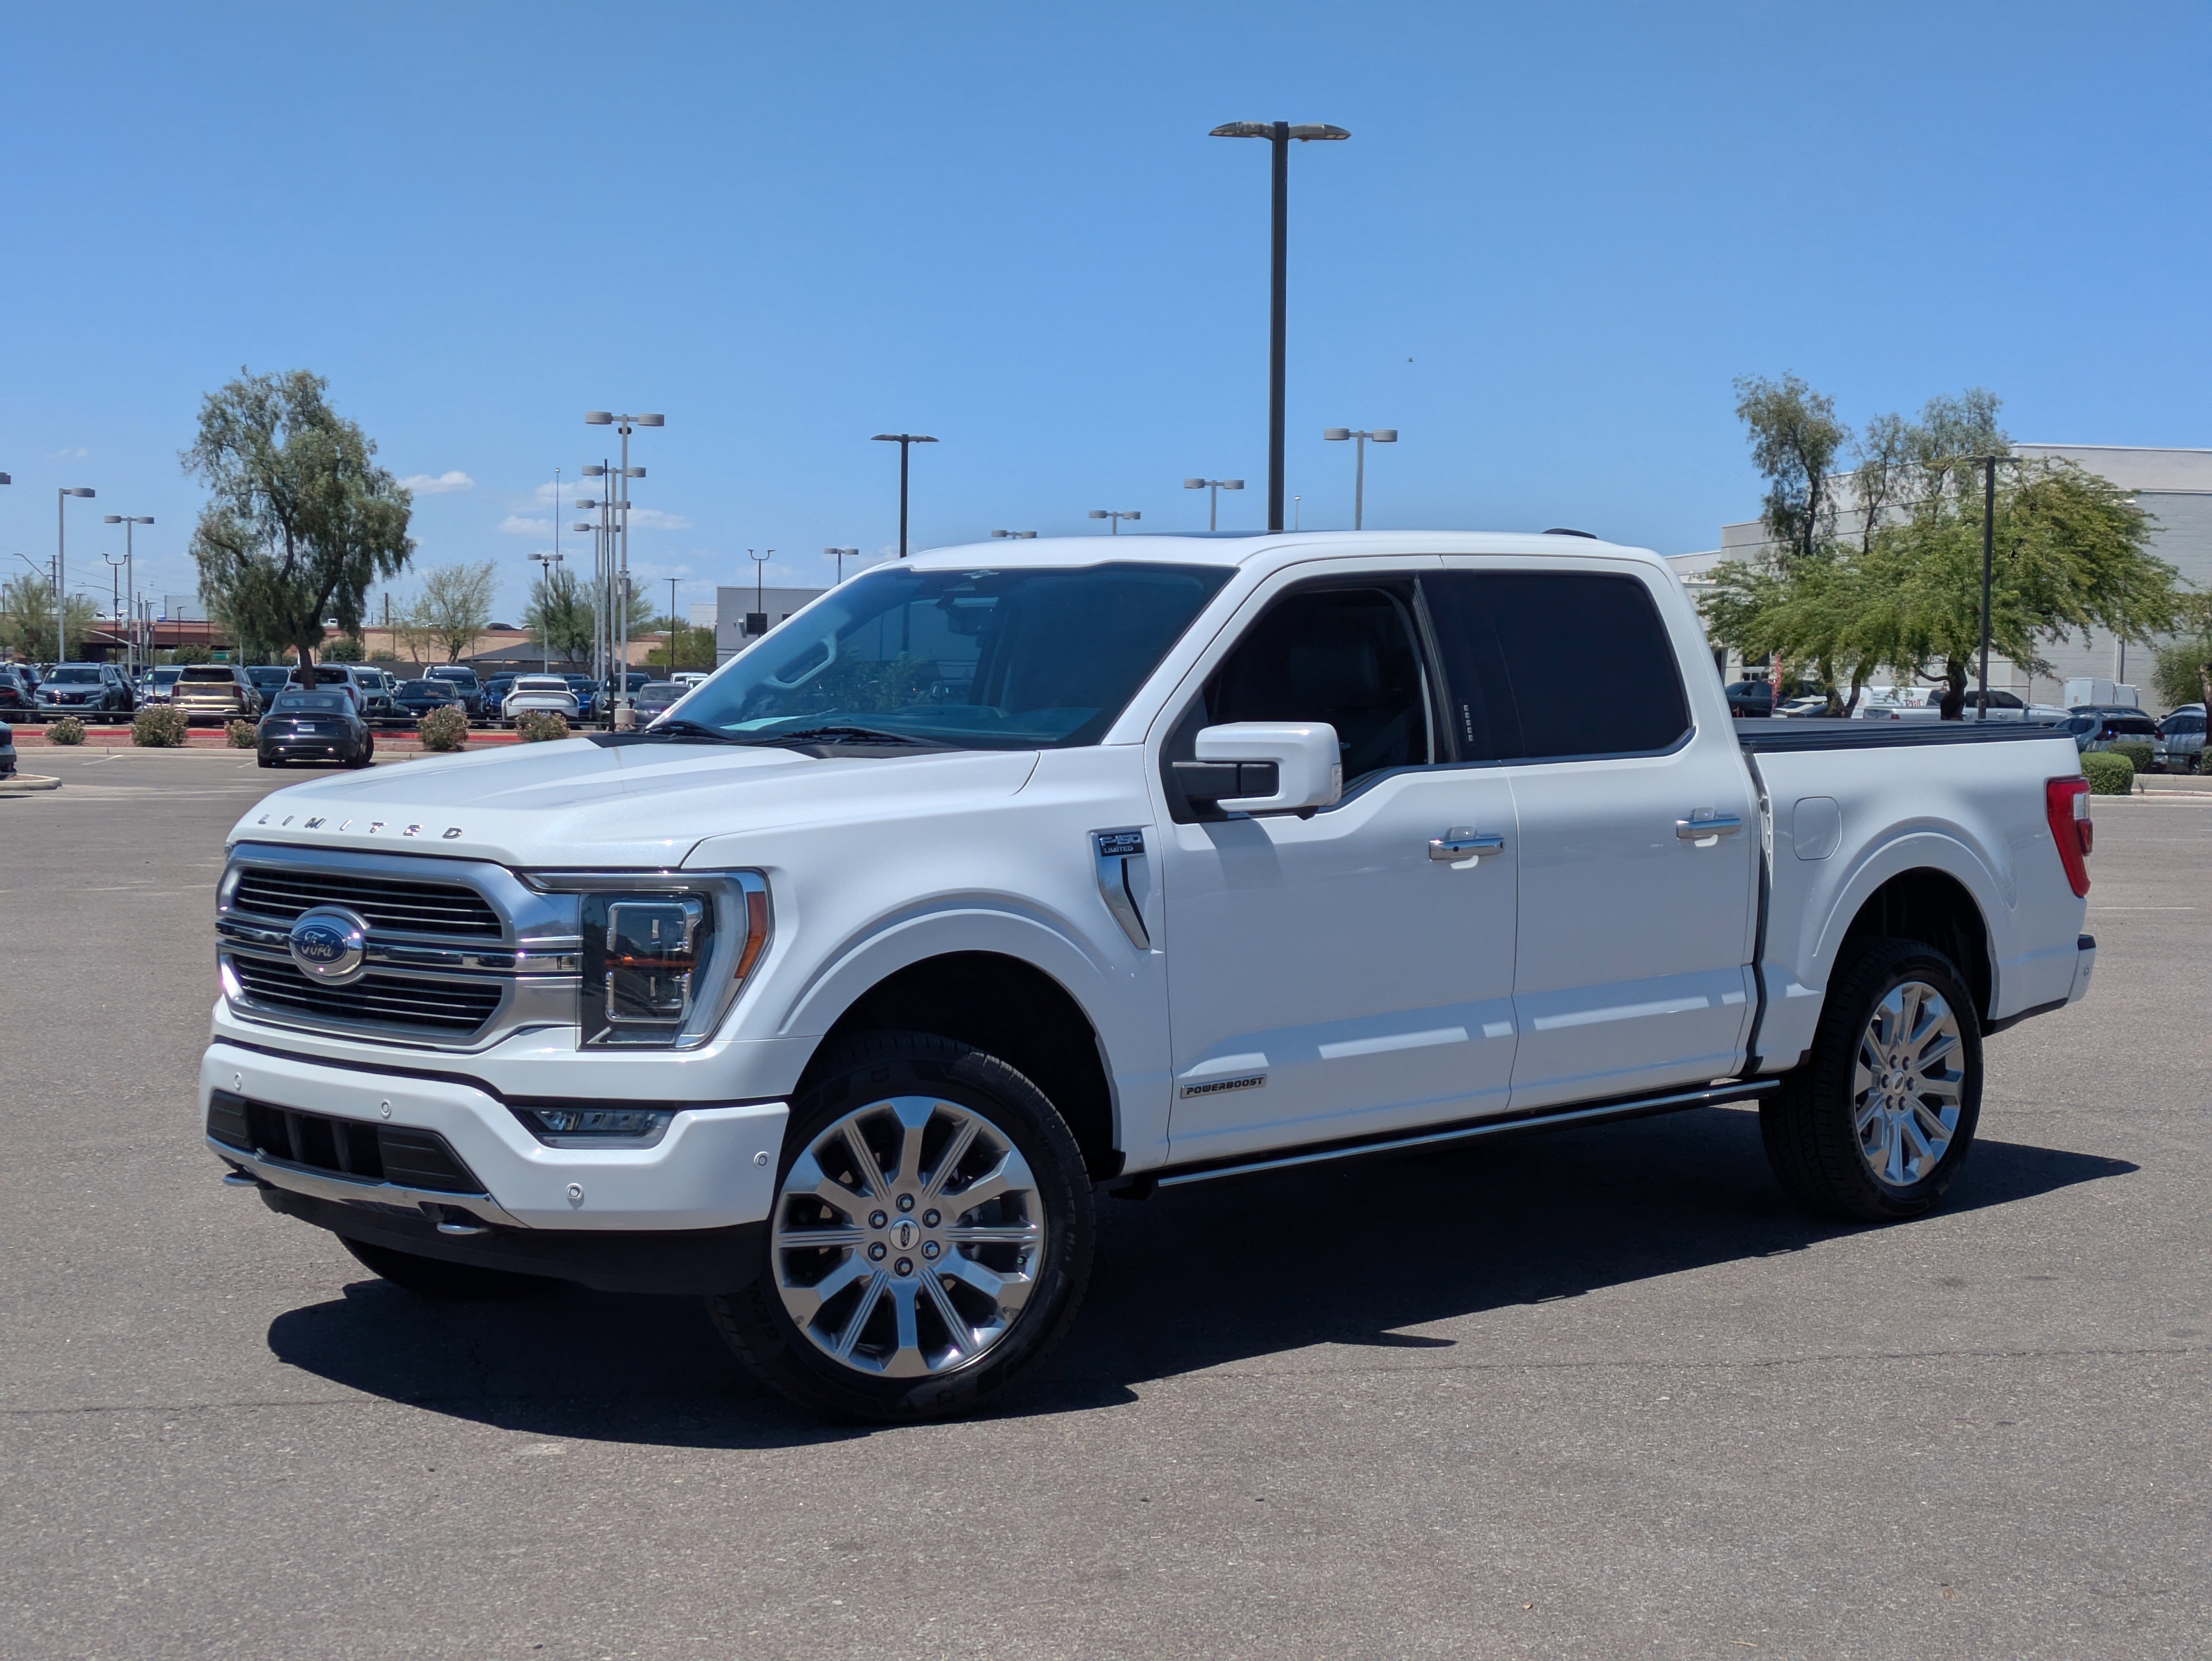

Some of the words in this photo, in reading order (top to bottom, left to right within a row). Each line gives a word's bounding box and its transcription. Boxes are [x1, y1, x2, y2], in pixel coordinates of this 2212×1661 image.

[258, 813, 463, 839] LIMITED
[1104, 845, 1133, 853] LIMITED
[301, 930, 335, 957] Ford
[1186, 1077, 1264, 1095] POWERBOOST
